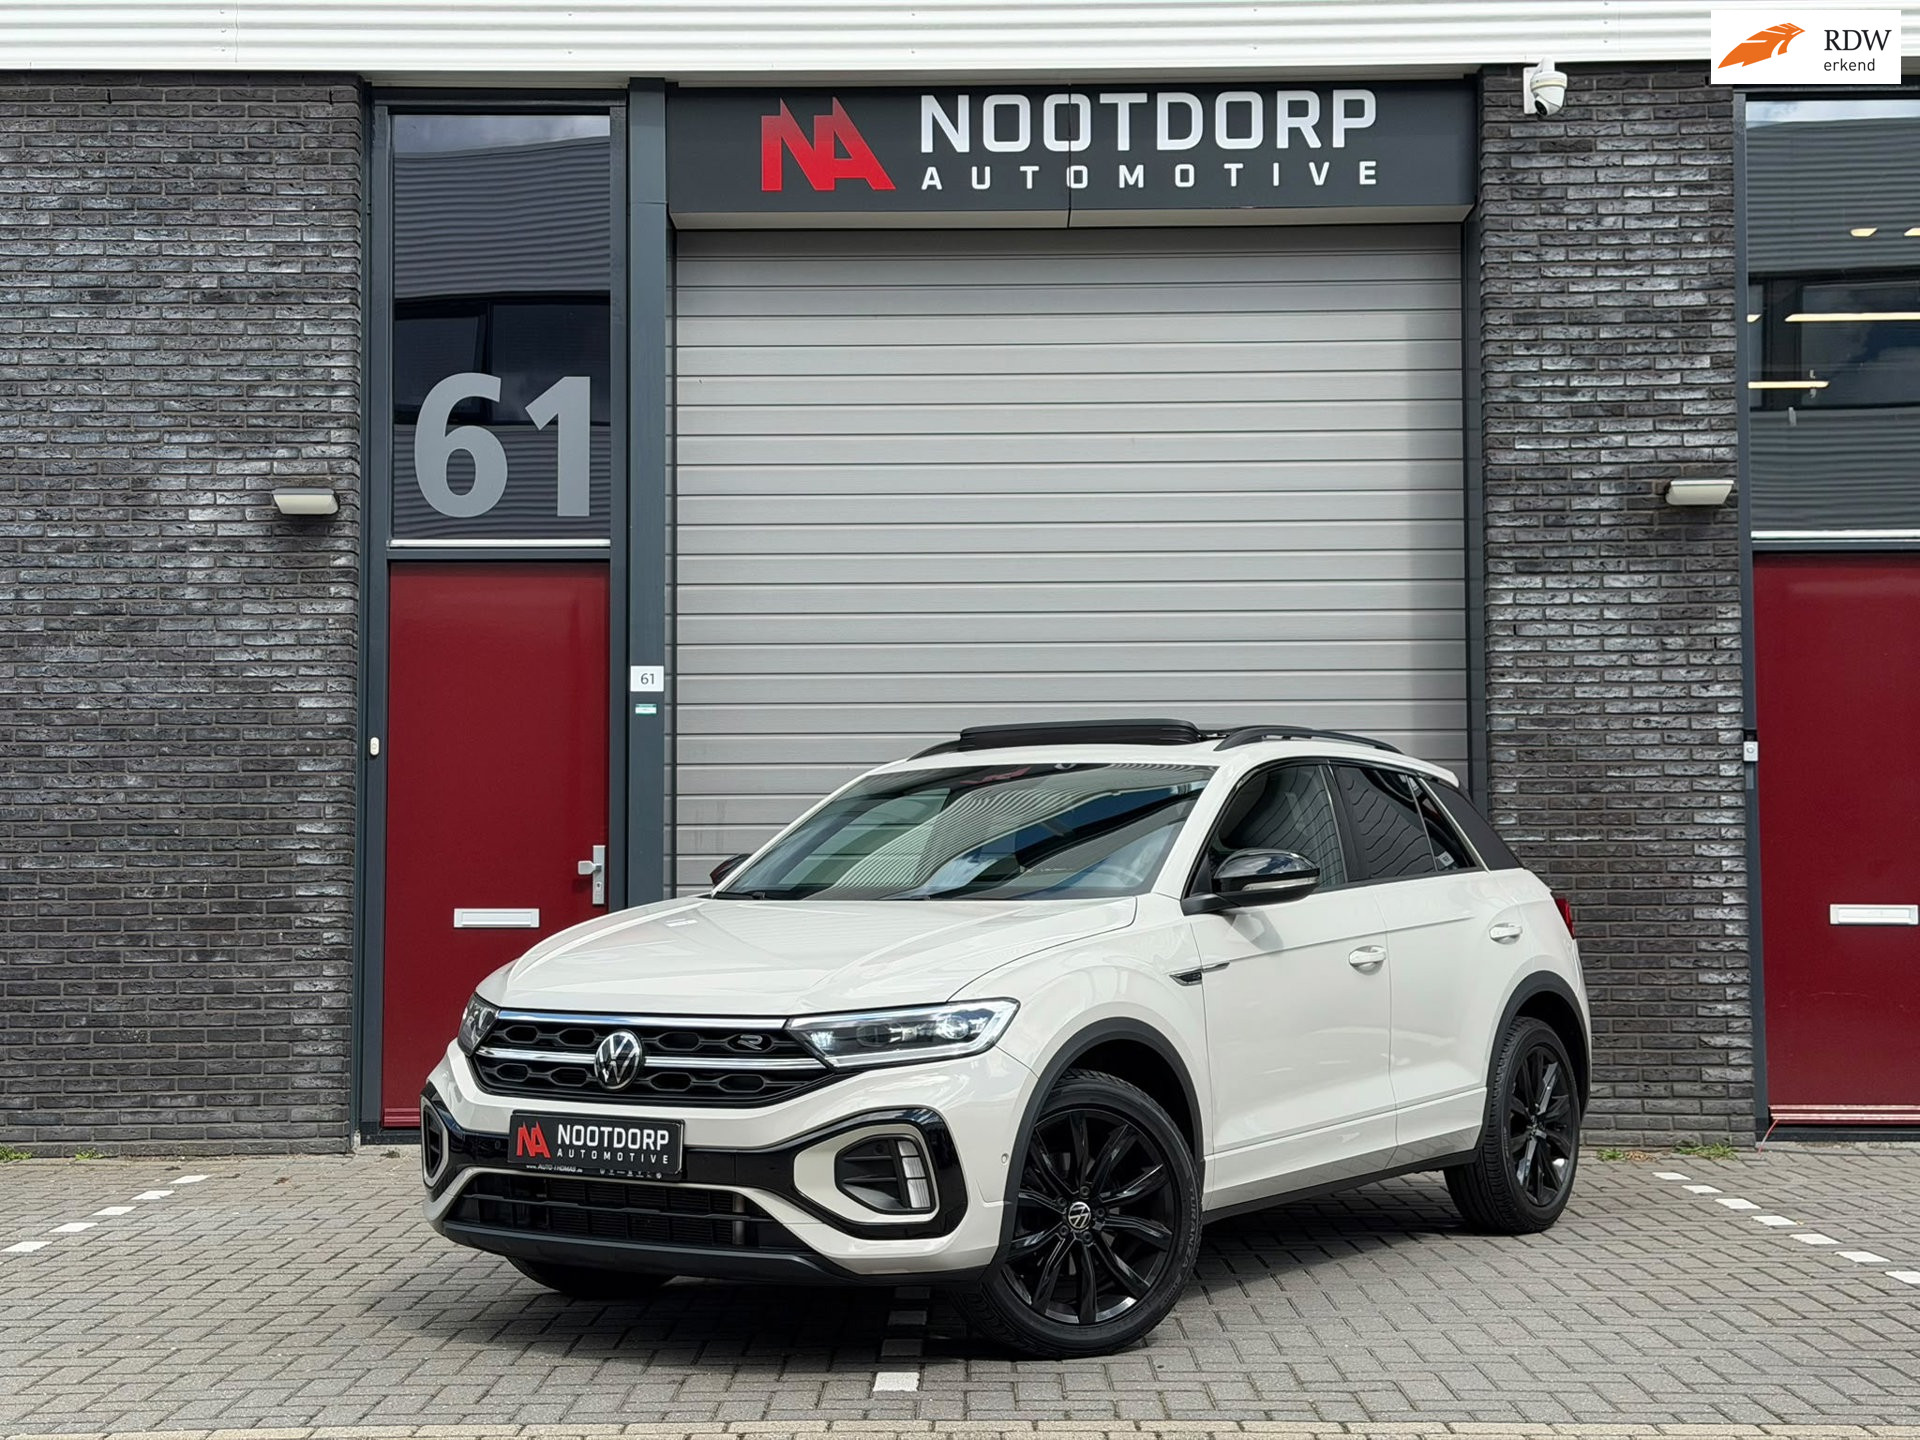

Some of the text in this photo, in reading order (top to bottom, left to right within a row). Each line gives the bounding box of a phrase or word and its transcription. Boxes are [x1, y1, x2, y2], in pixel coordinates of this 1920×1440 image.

[920, 89, 1377, 154] NOOTDORP
[920, 160, 1377, 191] AUTOMOTIVE
[414, 372, 591, 518] 61
[640, 672, 655, 685] 61
[557, 1123, 670, 1151] NOOTDORP
[557, 1149, 668, 1164] AUTOMOTIVE
